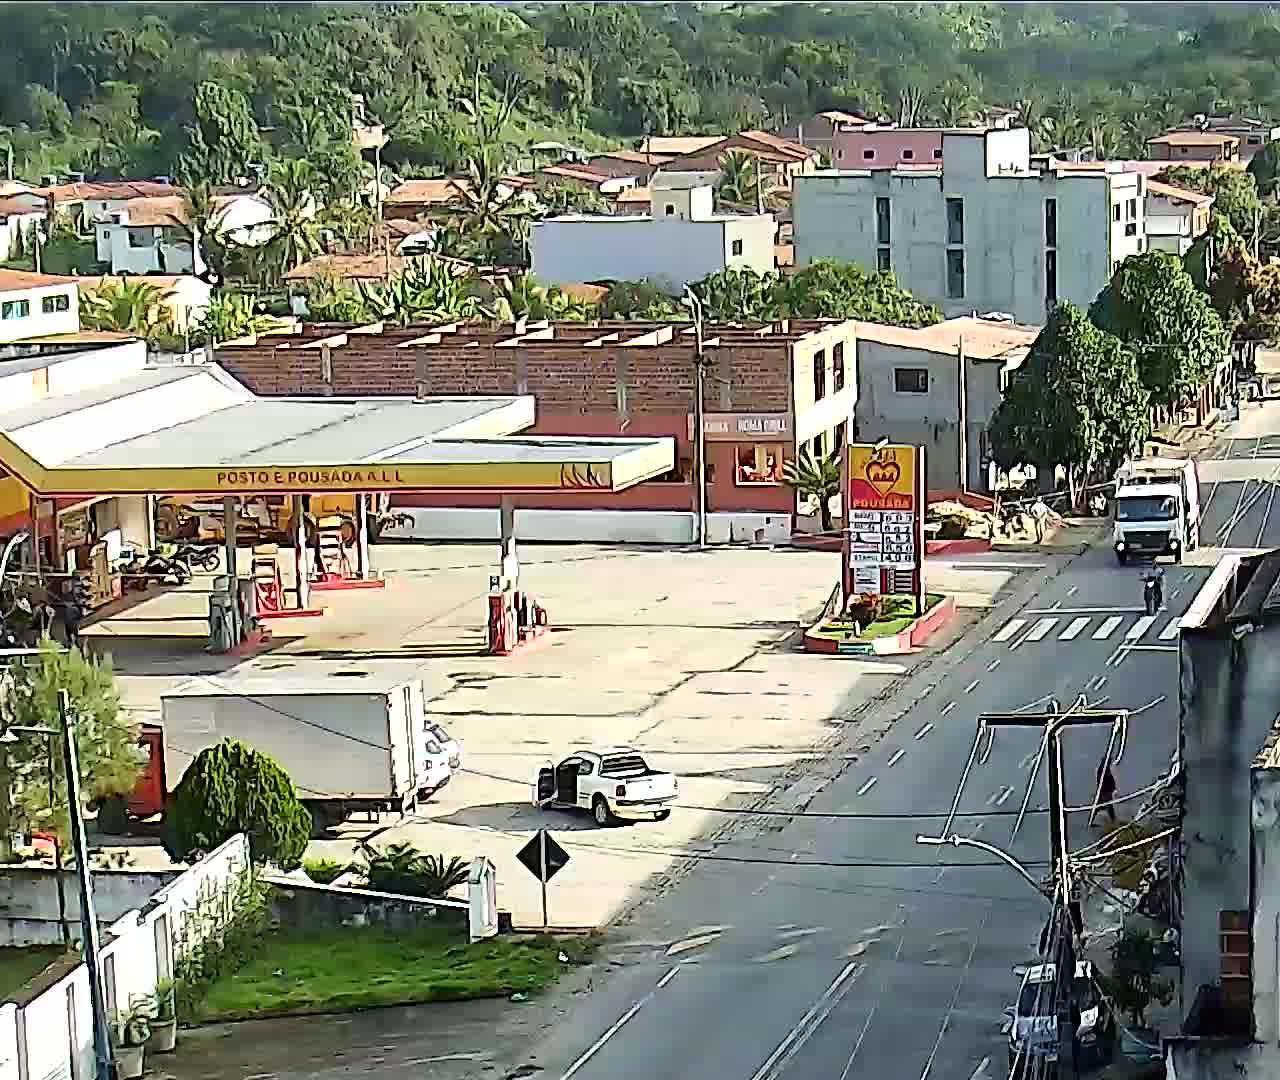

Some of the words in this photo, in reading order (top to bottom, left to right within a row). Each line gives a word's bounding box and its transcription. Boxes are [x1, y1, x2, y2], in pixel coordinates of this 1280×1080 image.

[217, 471, 269, 484] POSTO
[273, 470, 284, 484] E
[288, 470, 363, 483] POUSADA
[852, 498, 911, 509] POUSADA
